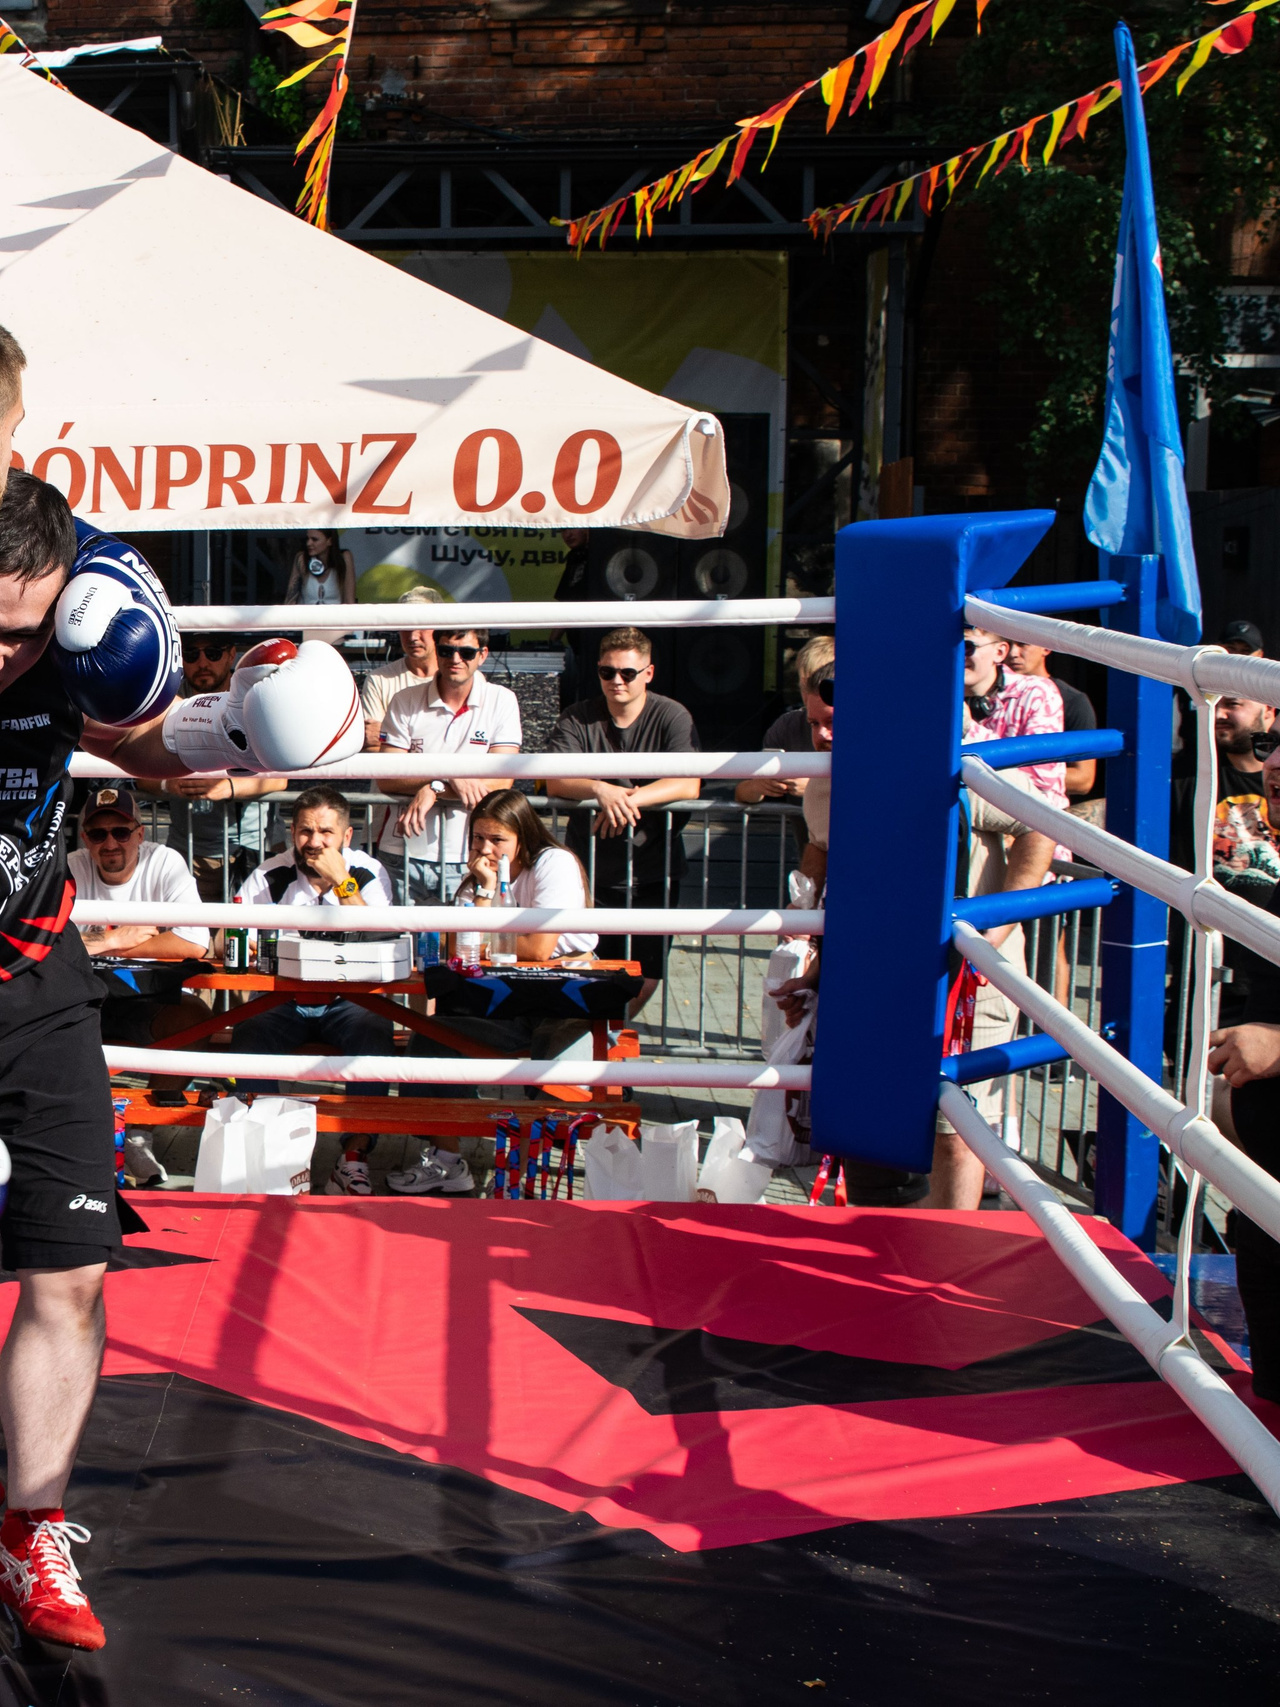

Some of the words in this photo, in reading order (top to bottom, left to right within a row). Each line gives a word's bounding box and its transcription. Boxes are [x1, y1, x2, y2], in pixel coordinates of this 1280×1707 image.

[11, 421, 418, 515] ÓNPRINZ
[453, 428, 623, 514] 0.0
[73, 586, 98, 627] UNIQUE
[1, 713, 51, 731] FARFOR
